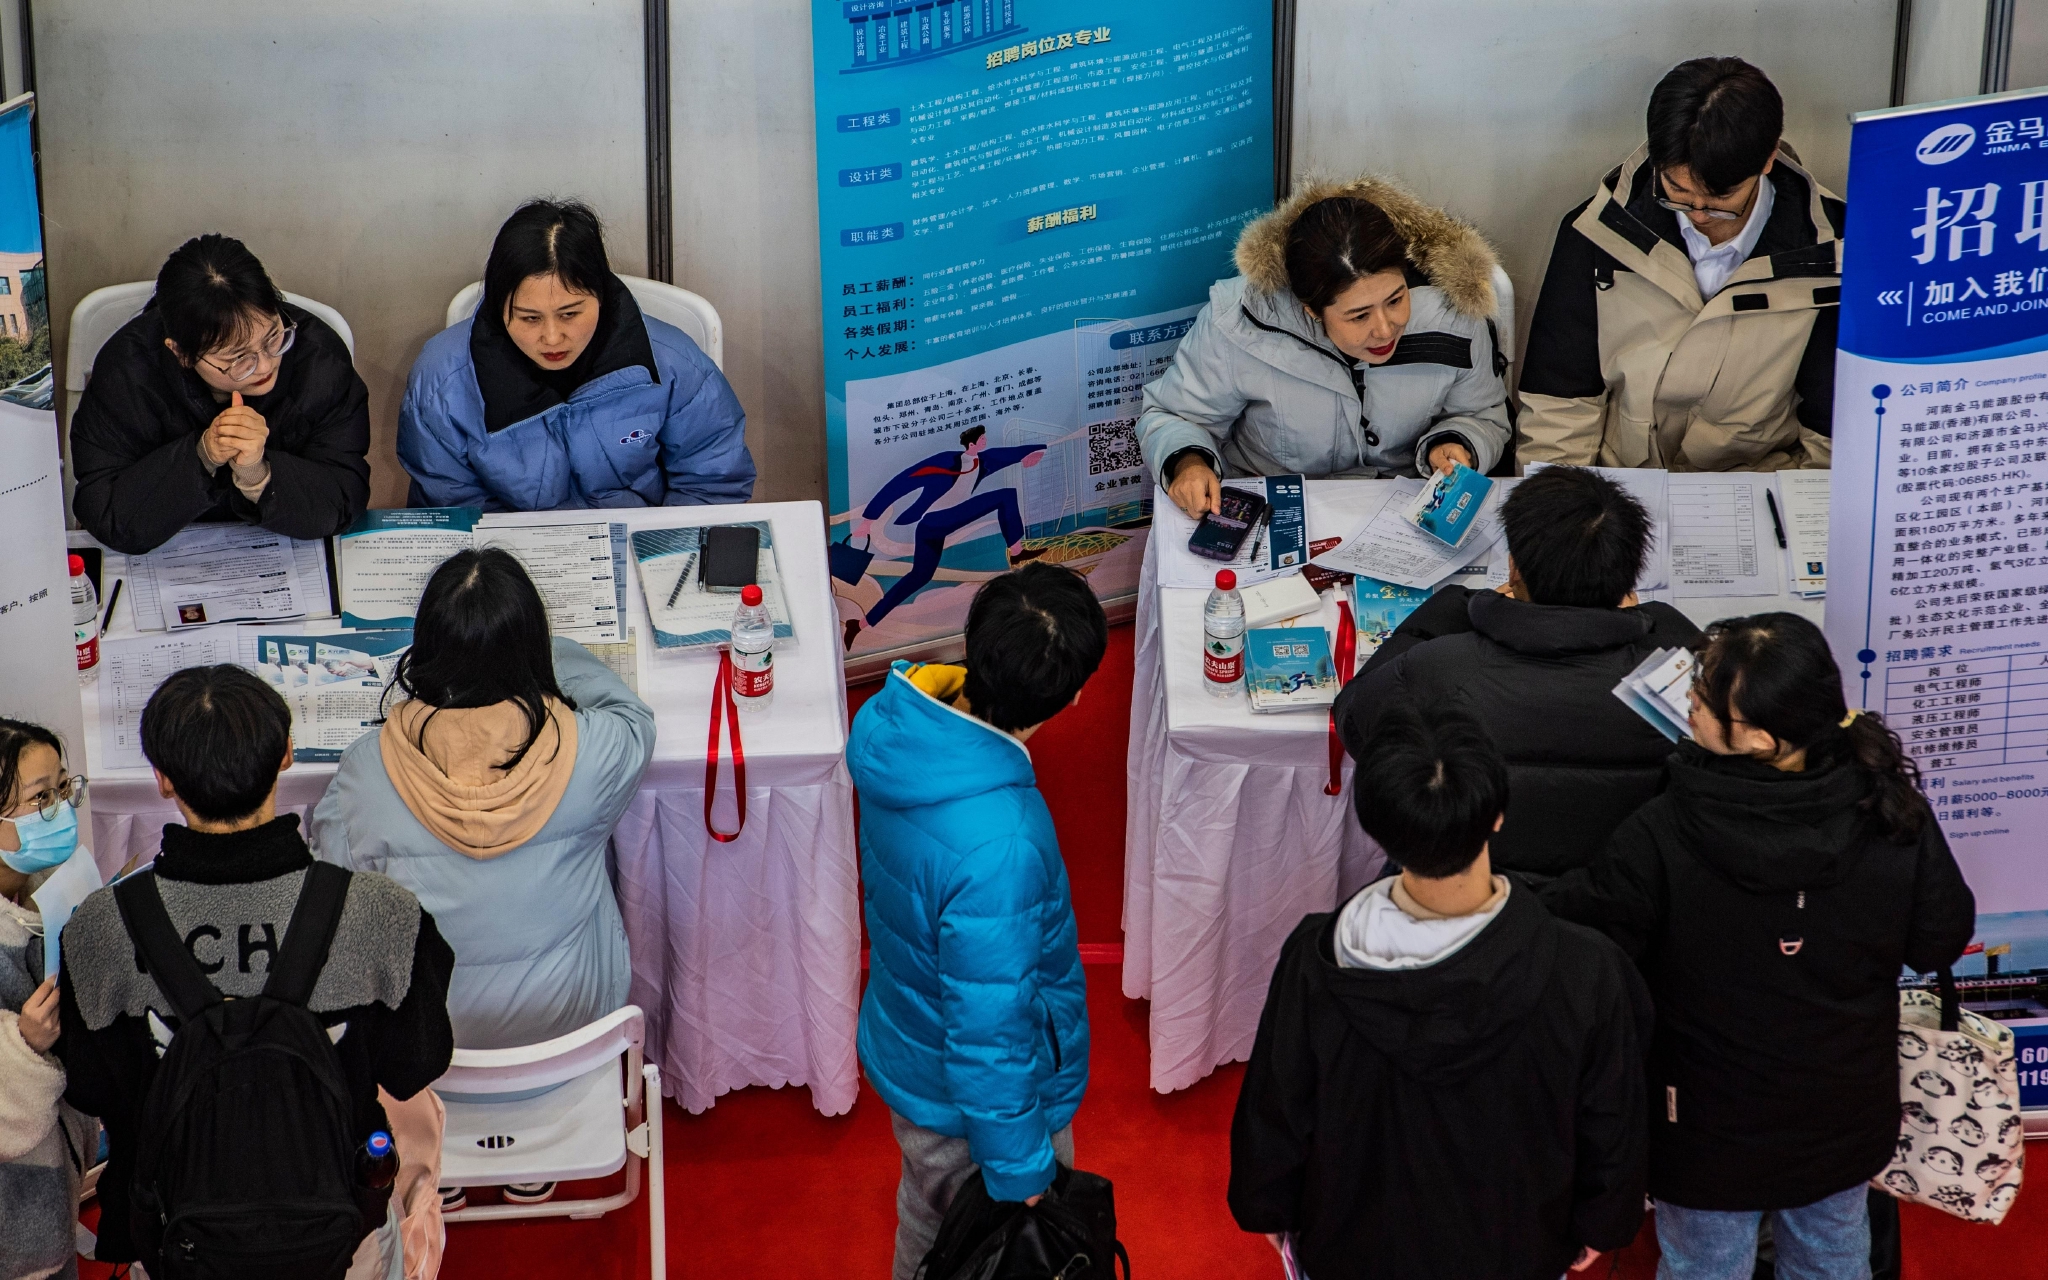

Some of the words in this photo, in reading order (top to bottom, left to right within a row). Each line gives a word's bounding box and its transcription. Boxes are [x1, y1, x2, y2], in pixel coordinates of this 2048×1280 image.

[851, 1, 885, 12] 设计咨询
[856, 28, 865, 57] 设计咨询
[878, 25, 887, 54] 冶金工业
[900, 21, 909, 50] 建筑工程
[986, 27, 1111, 69] 招聘岗位及专业
[848, 113, 891, 128] 工程类
[911, 134, 935, 145] 关专业
[1985, 116, 2045, 145] 金马
[1982, 142, 2031, 156] JINMA
[849, 167, 892, 183] 设计类
[912, 187, 945, 200] 相关专业
[1027, 204, 1097, 244] 薪酬福利
[851, 228, 894, 243] 职能类
[842, 275, 914, 296] 员工薪酬：
[1923, 266, 2048, 307] 加入我们
[843, 297, 915, 318] 员工福利：
[1922, 308, 1971, 325] COME
[1973, 303, 2008, 318] AND
[2012, 297, 2048, 313] JOIN
[844, 319, 915, 339] 各类假期：
[1129, 320, 1195, 345] 联系方式
[844, 341, 916, 360] 个人发展：
[1087, 354, 1174, 377] 公司总部地址：上海市
[1901, 378, 1969, 397] 公司简介
[1975, 377, 2017, 388] Company
[1926, 391, 2048, 416] 河南金马能源股份有
[1094, 475, 1142, 492] 企业官微
[1920, 481, 2048, 506] 公司现有两个生产基
[1895, 497, 2048, 523] 区化工园区（本部）、河
[1893, 540, 2048, 568] 用一体化的完整产业链。
[1886, 645, 1953, 663] 招聘需求
[2014, 641, 2041, 650] needs
[1914, 677, 1982, 693] 电气工程师
[1912, 693, 1981, 709] 化工工程师
[1912, 708, 1980, 725] 液压工程师
[1911, 723, 1979, 740] 安全管理员
[1910, 739, 1978, 756] 机修维修员
[1930, 757, 1957, 769] 普工
[1982, 828, 2010, 836] online
